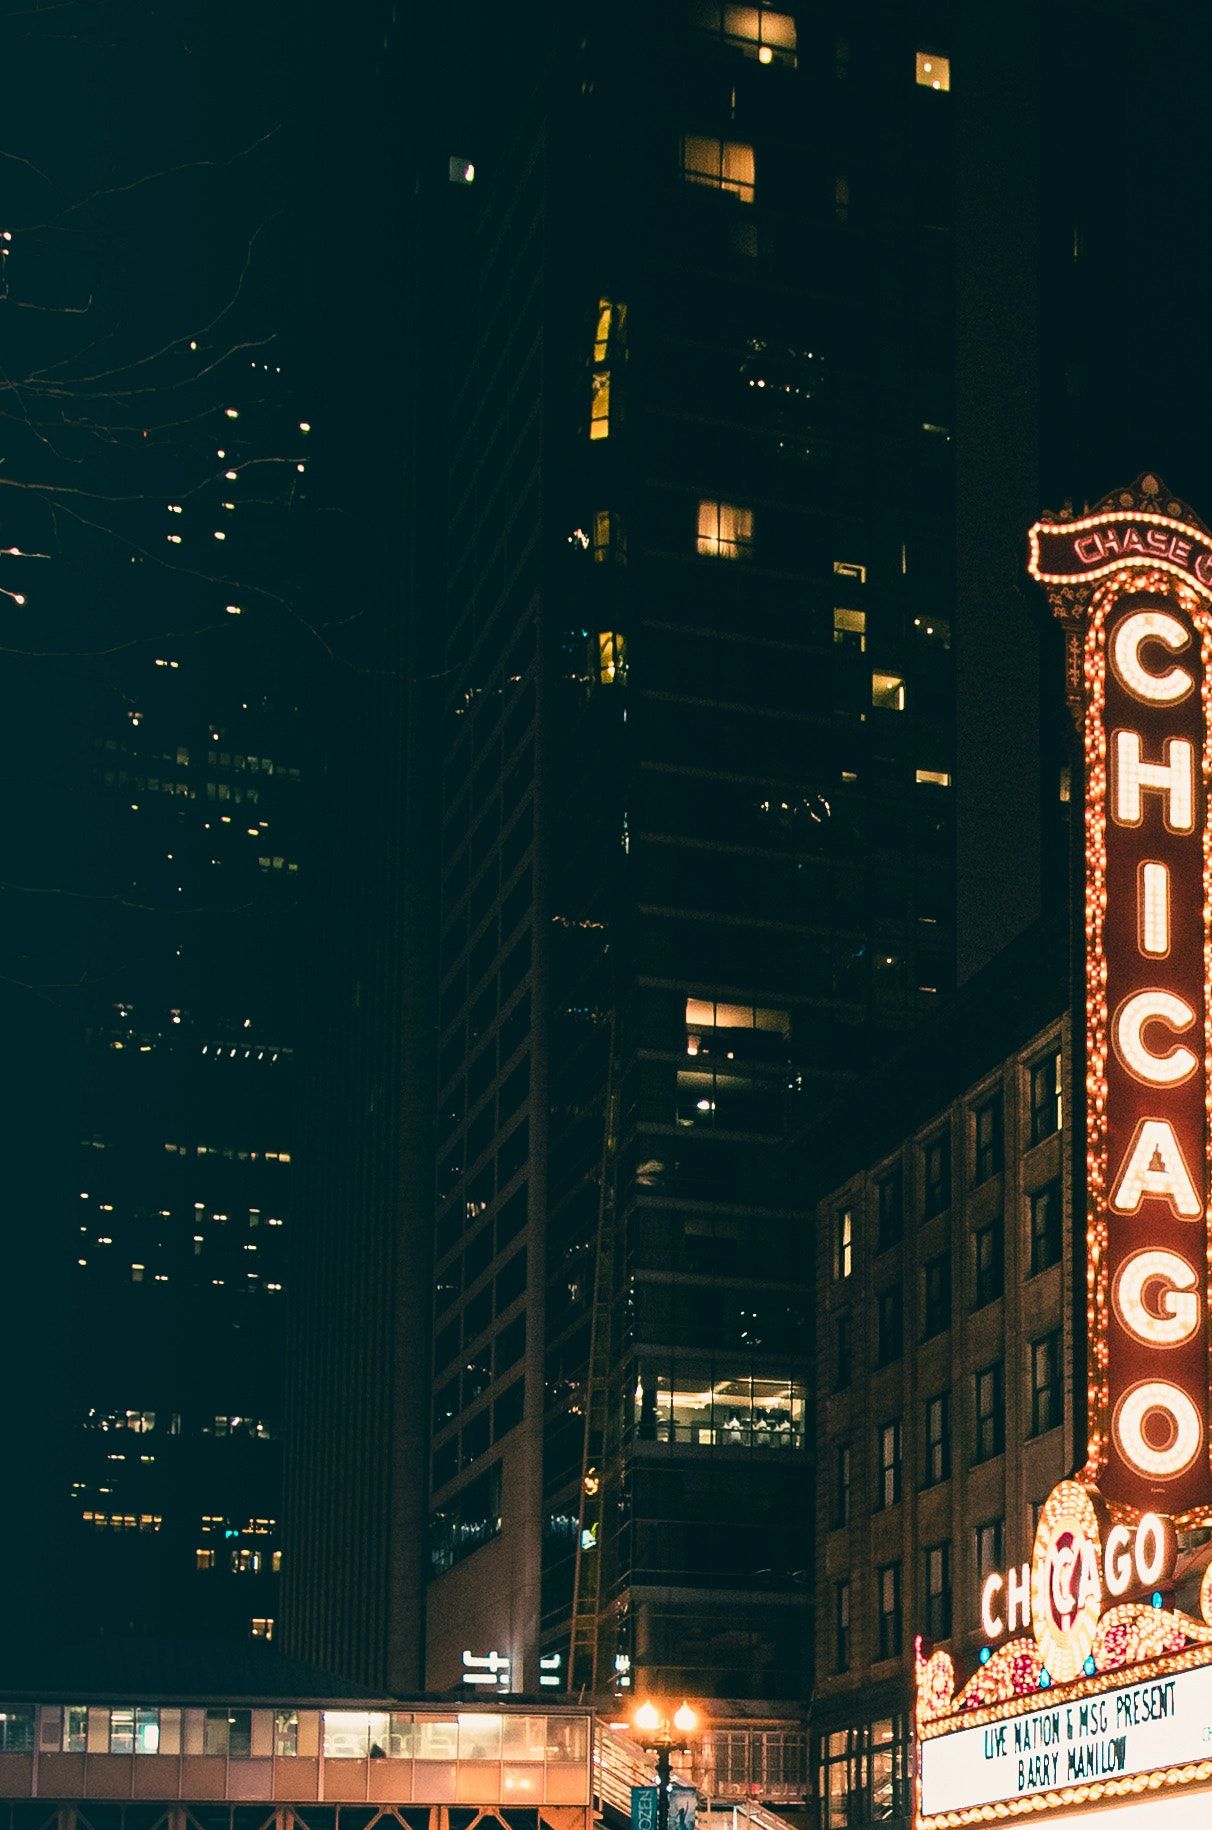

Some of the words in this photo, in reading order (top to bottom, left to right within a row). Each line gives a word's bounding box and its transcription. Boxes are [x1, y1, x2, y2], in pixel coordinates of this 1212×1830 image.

[1074, 527, 1192, 567] CHASE
[1110, 608, 1202, 1480] CHICAGO
[981, 1512, 1165, 1638] CHICAGO
[985, 1726, 1007, 1760] LIVE
[1014, 1711, 1060, 1753] NATION
[1079, 1703, 1108, 1737] MSG
[1116, 1681, 1175, 1728] PRESENT
[1018, 1751, 1058, 1791] BARRY
[1068, 1736, 1127, 1781] MANILOW
